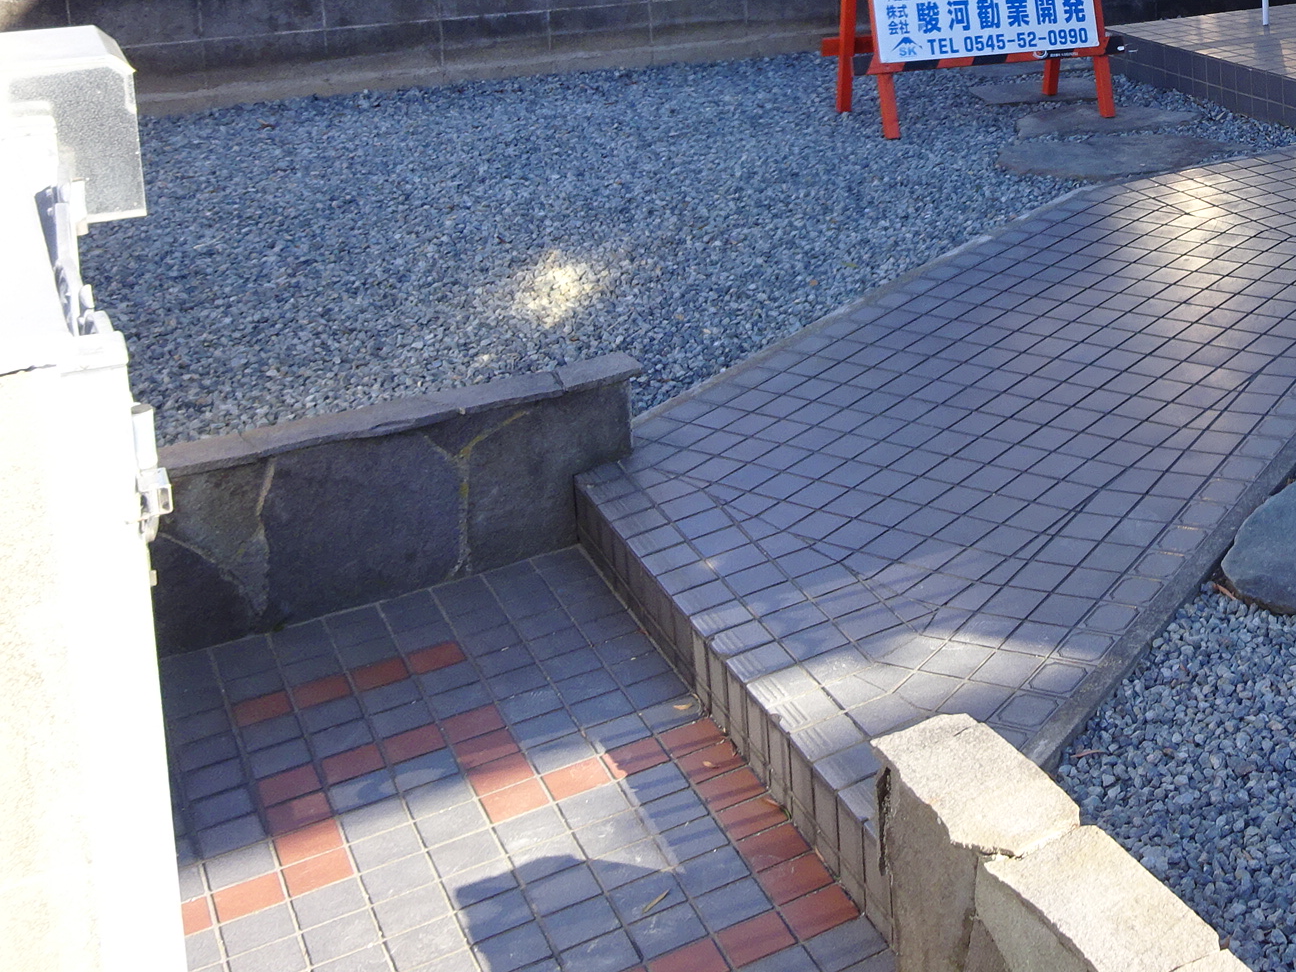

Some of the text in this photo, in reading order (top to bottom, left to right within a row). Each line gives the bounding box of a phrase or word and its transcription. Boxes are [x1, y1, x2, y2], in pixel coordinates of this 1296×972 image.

[886, 4, 909, 20] 株式
[888, 19, 911, 36] 会社
[927, 27, 1089, 56] TEL 0545-52-0990
[899, 46, 918, 57] SK
